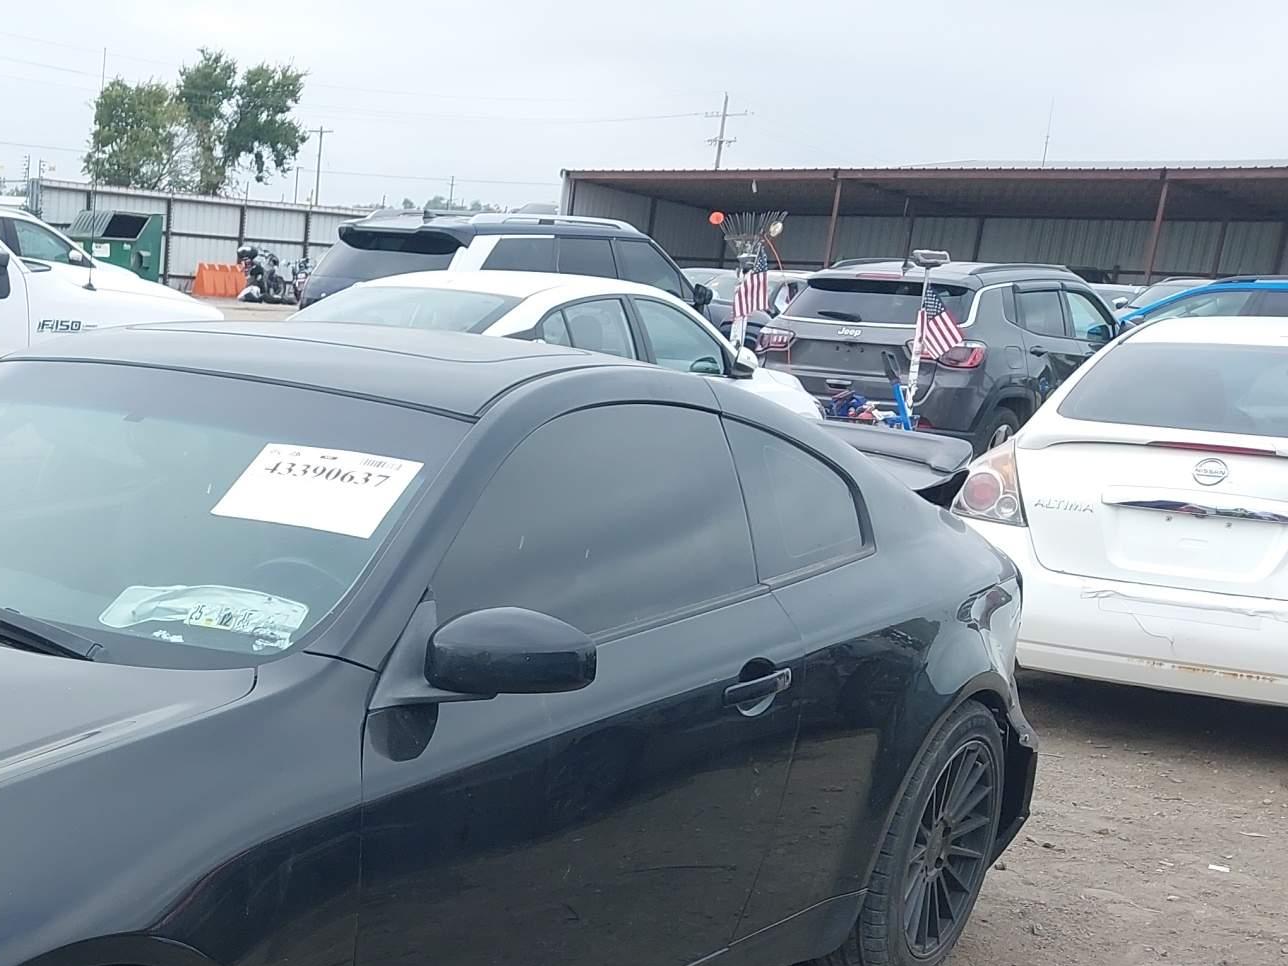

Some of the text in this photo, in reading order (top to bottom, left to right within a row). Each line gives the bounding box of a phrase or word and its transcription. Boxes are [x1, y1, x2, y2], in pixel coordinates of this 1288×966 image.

[837, 327, 862, 337] Jeep
[264, 461, 391, 487] 43390637
[1034, 499, 1094, 513] ALTIMA
